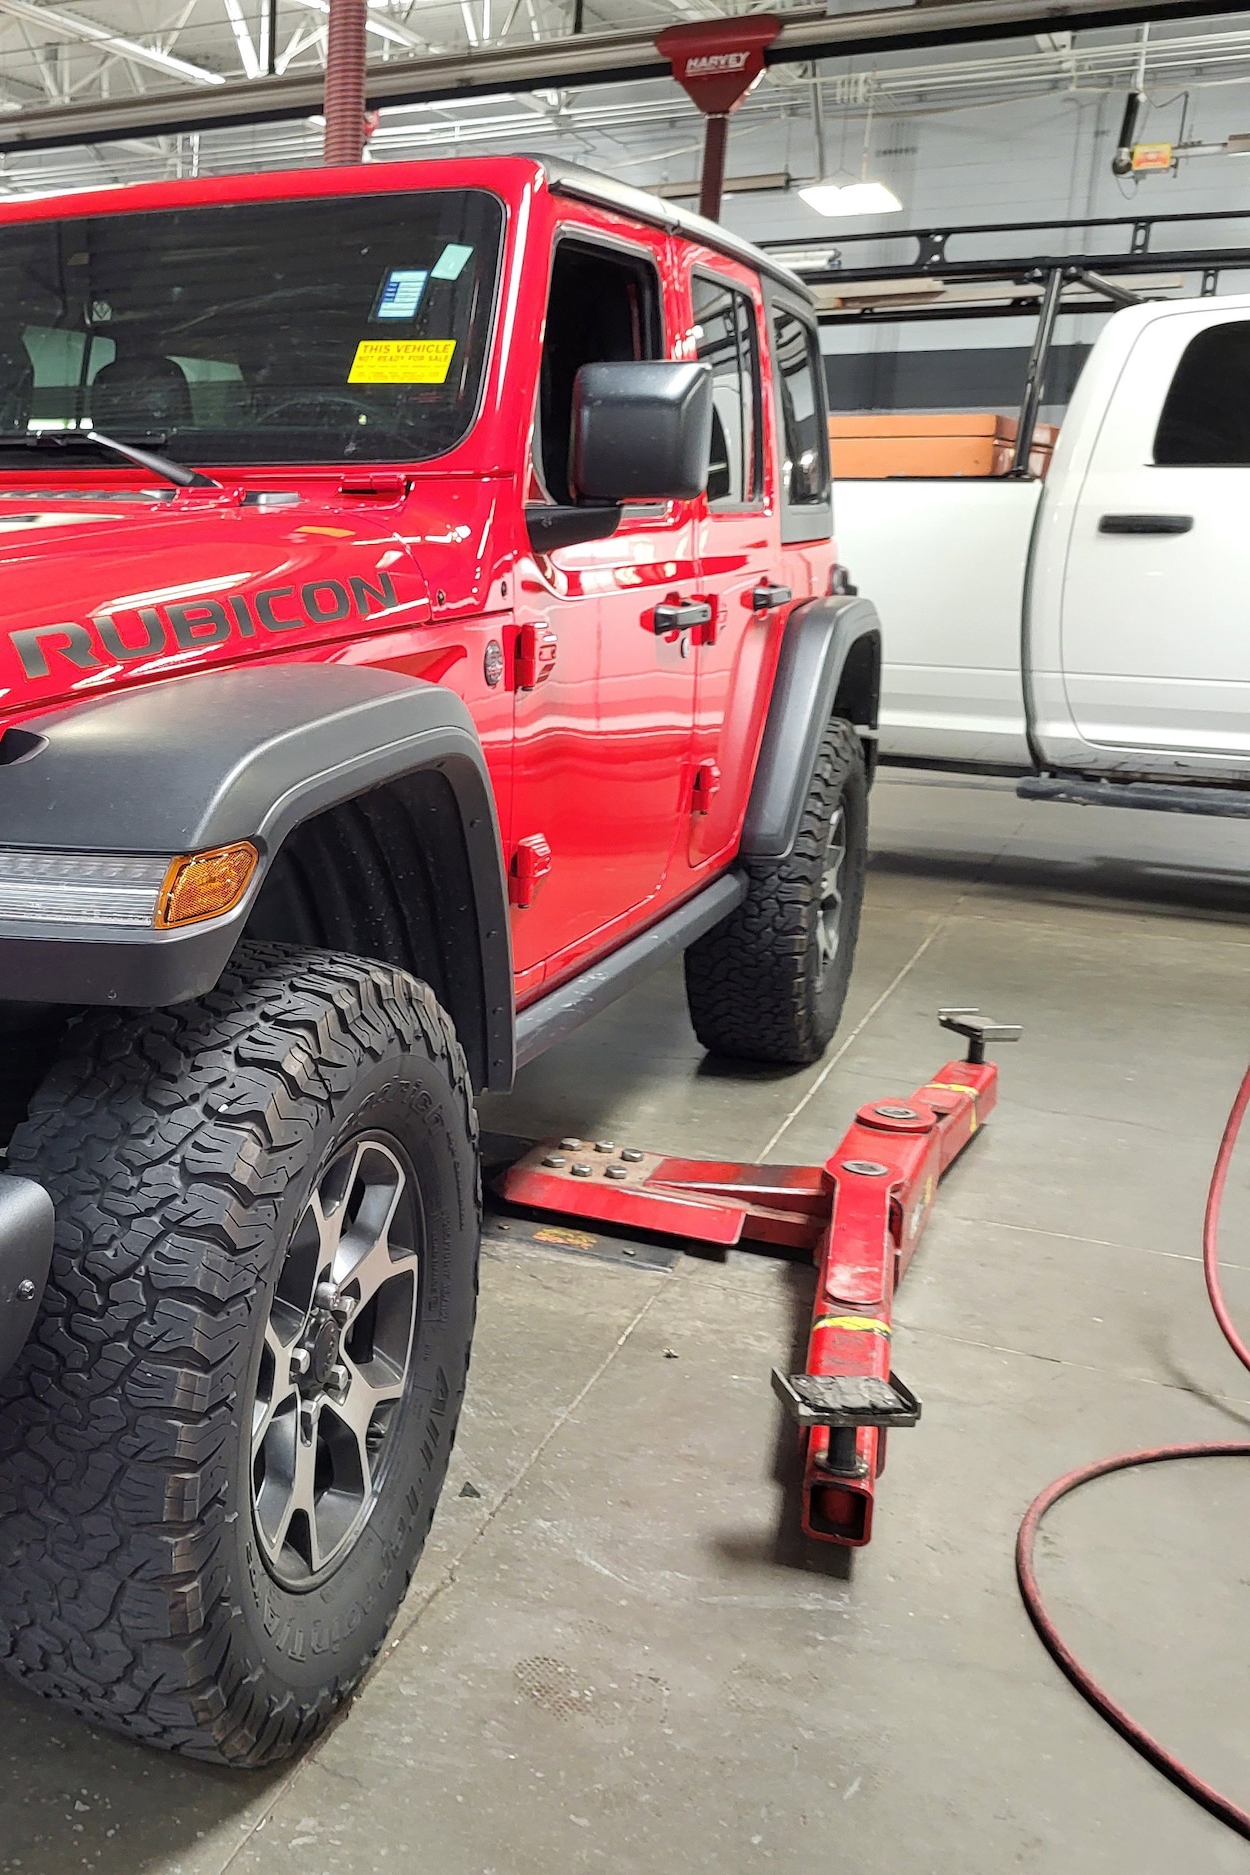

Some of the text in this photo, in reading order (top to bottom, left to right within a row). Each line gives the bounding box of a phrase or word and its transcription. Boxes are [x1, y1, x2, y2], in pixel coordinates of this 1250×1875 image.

[685, 51, 750, 72] HARVEY
[363, 344, 451, 354] THIS VEHICLE
[358, 355, 449, 363] NOT READY FOR SALE
[9, 572, 401, 681] RUBICON
